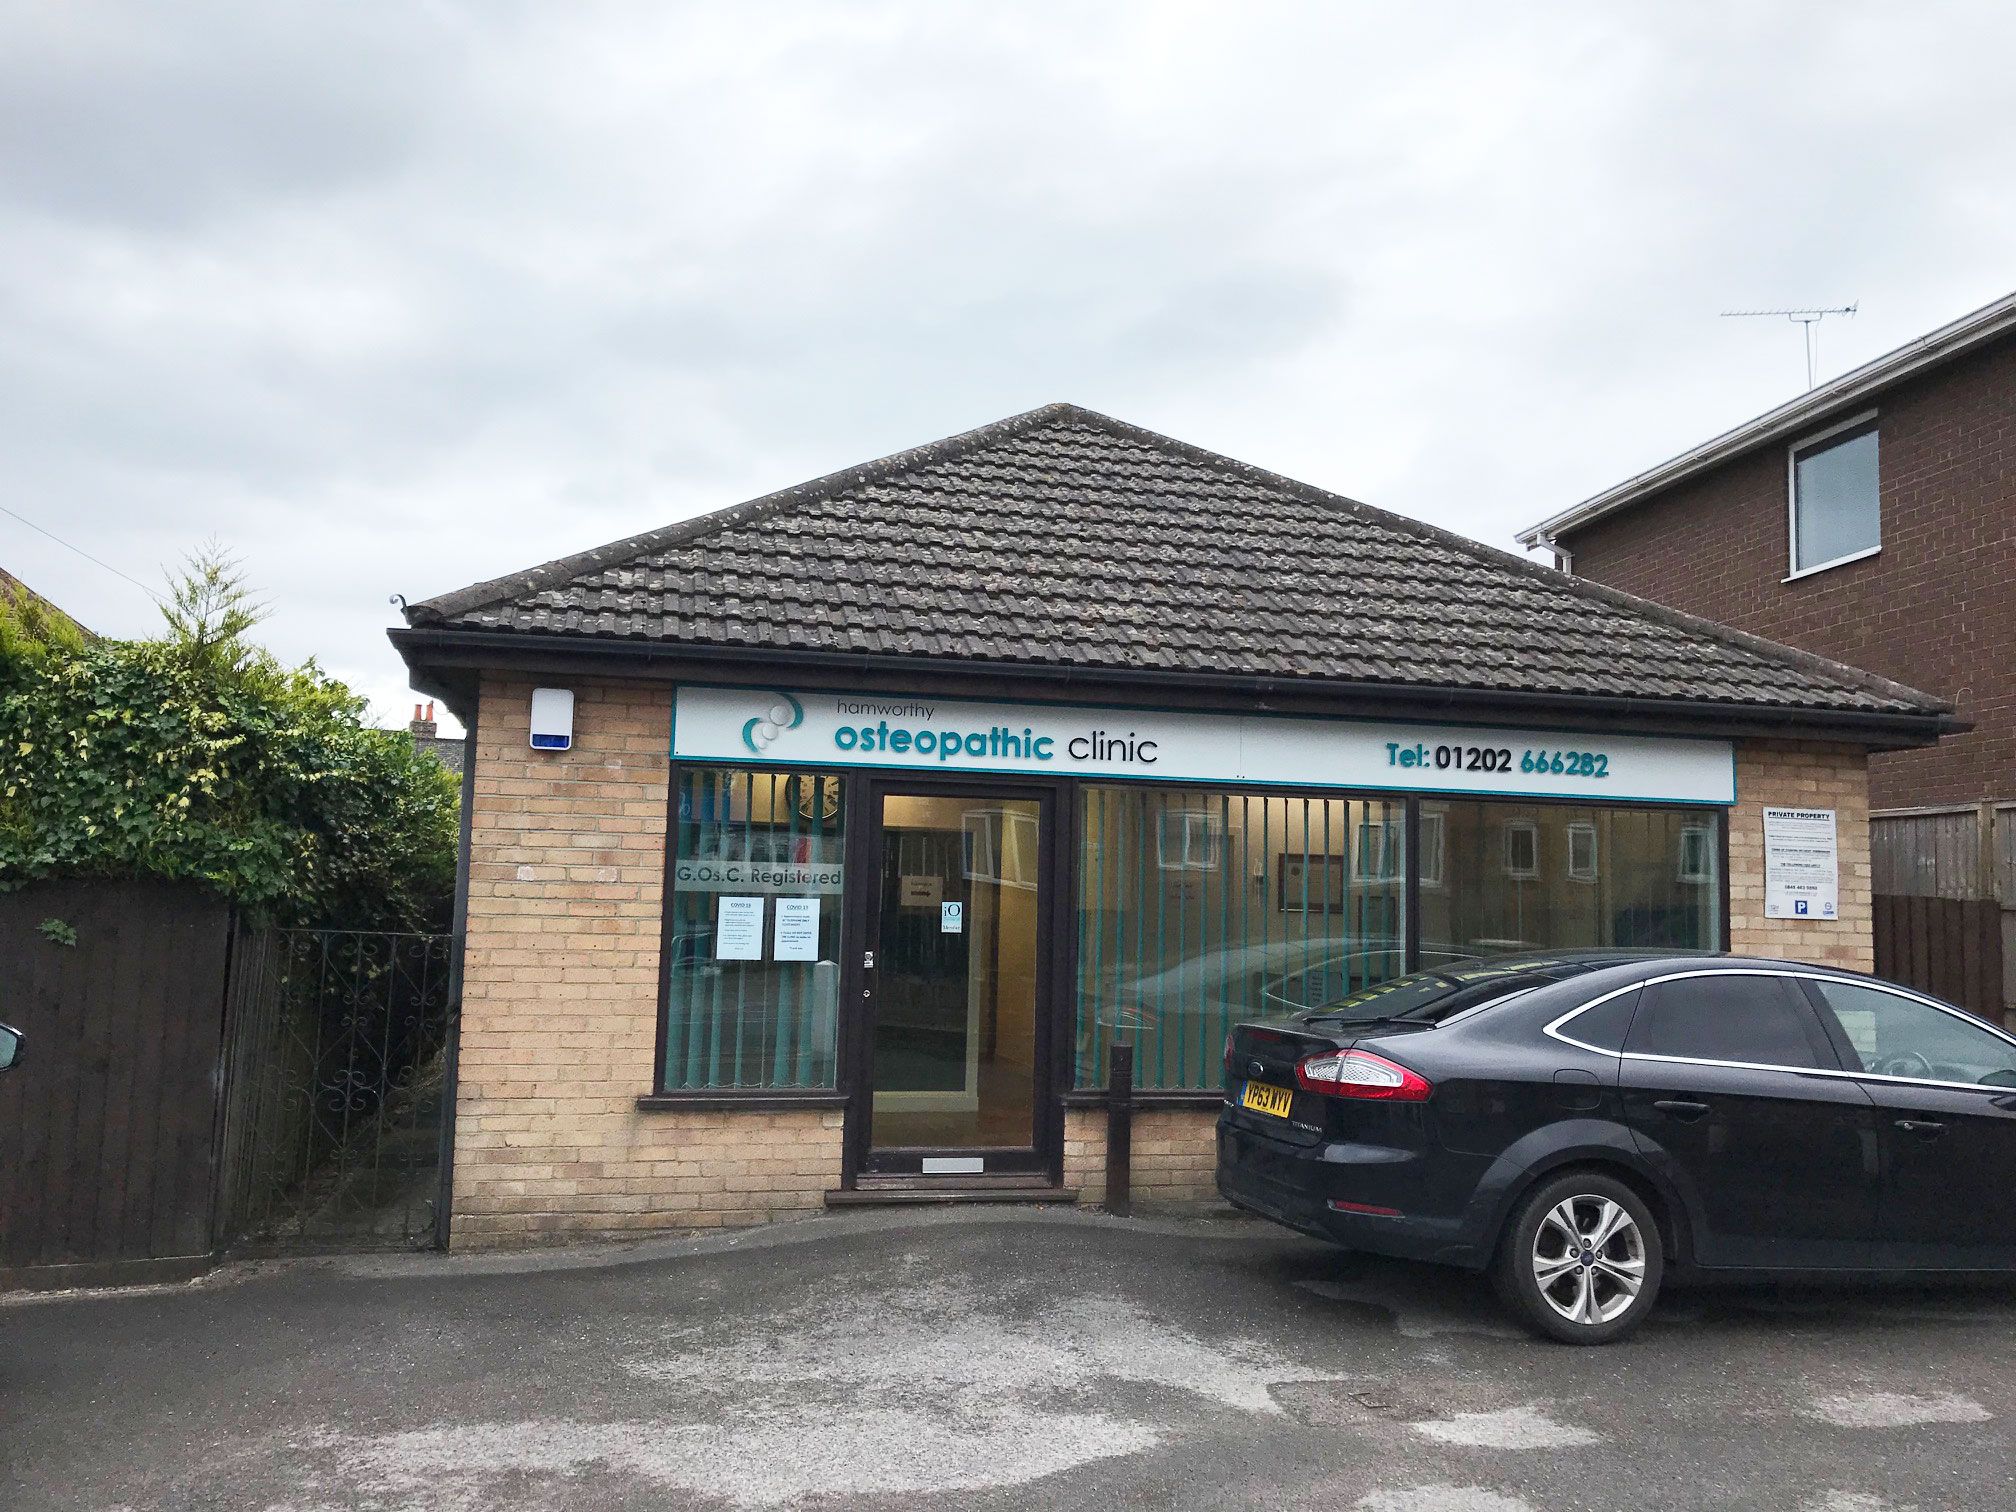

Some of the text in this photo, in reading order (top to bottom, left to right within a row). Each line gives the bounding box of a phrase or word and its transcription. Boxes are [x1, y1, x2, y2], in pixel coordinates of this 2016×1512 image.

[837, 700, 935, 720] hamworthy
[834, 721, 1158, 763] osteopathic clinic
[1387, 743, 1609, 778] Tel: 01202 666282
[677, 867, 841, 887] G.Os.C. Registered
[1247, 1083, 1270, 1107] YP63
[1292, 1120, 1323, 1133] TITANIUM
